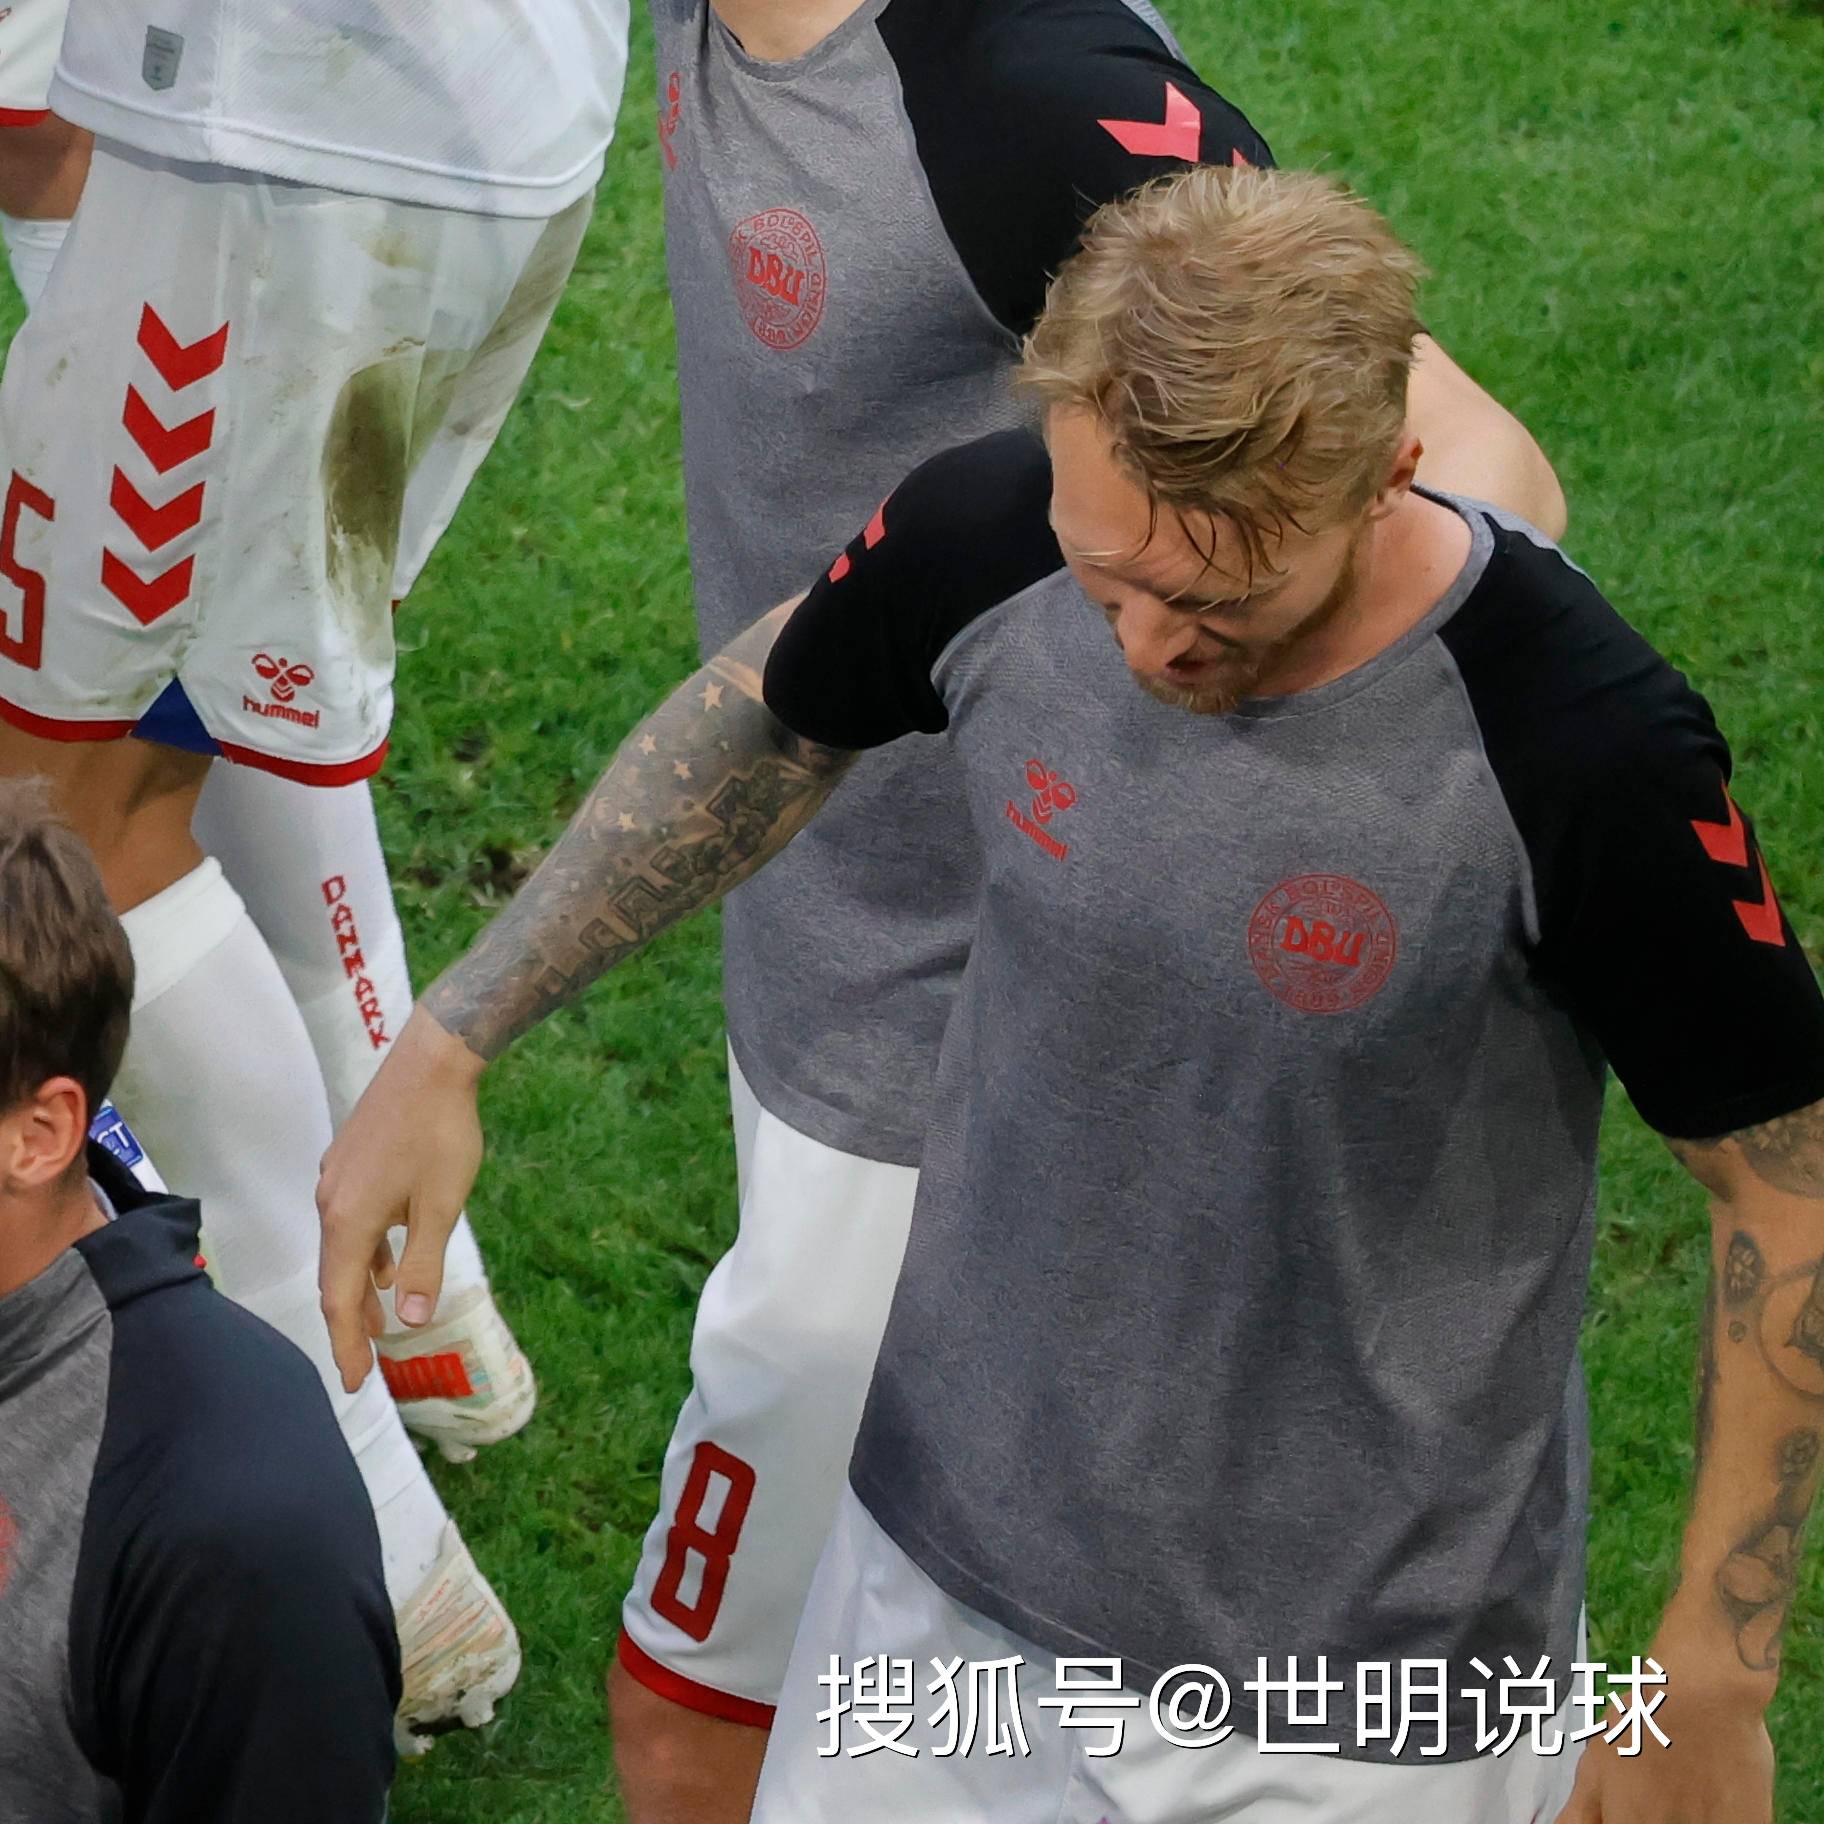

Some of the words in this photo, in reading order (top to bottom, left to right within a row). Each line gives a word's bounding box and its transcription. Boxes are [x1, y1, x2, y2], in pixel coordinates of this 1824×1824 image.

[746, 246, 805, 306] DBU
[242, 695, 319, 730] hummel
[1006, 799, 1069, 862] hummel
[321, 874, 392, 1051] DANMARK
[1280, 914, 1368, 967] DBU
[651, 1440, 757, 1642] 8
